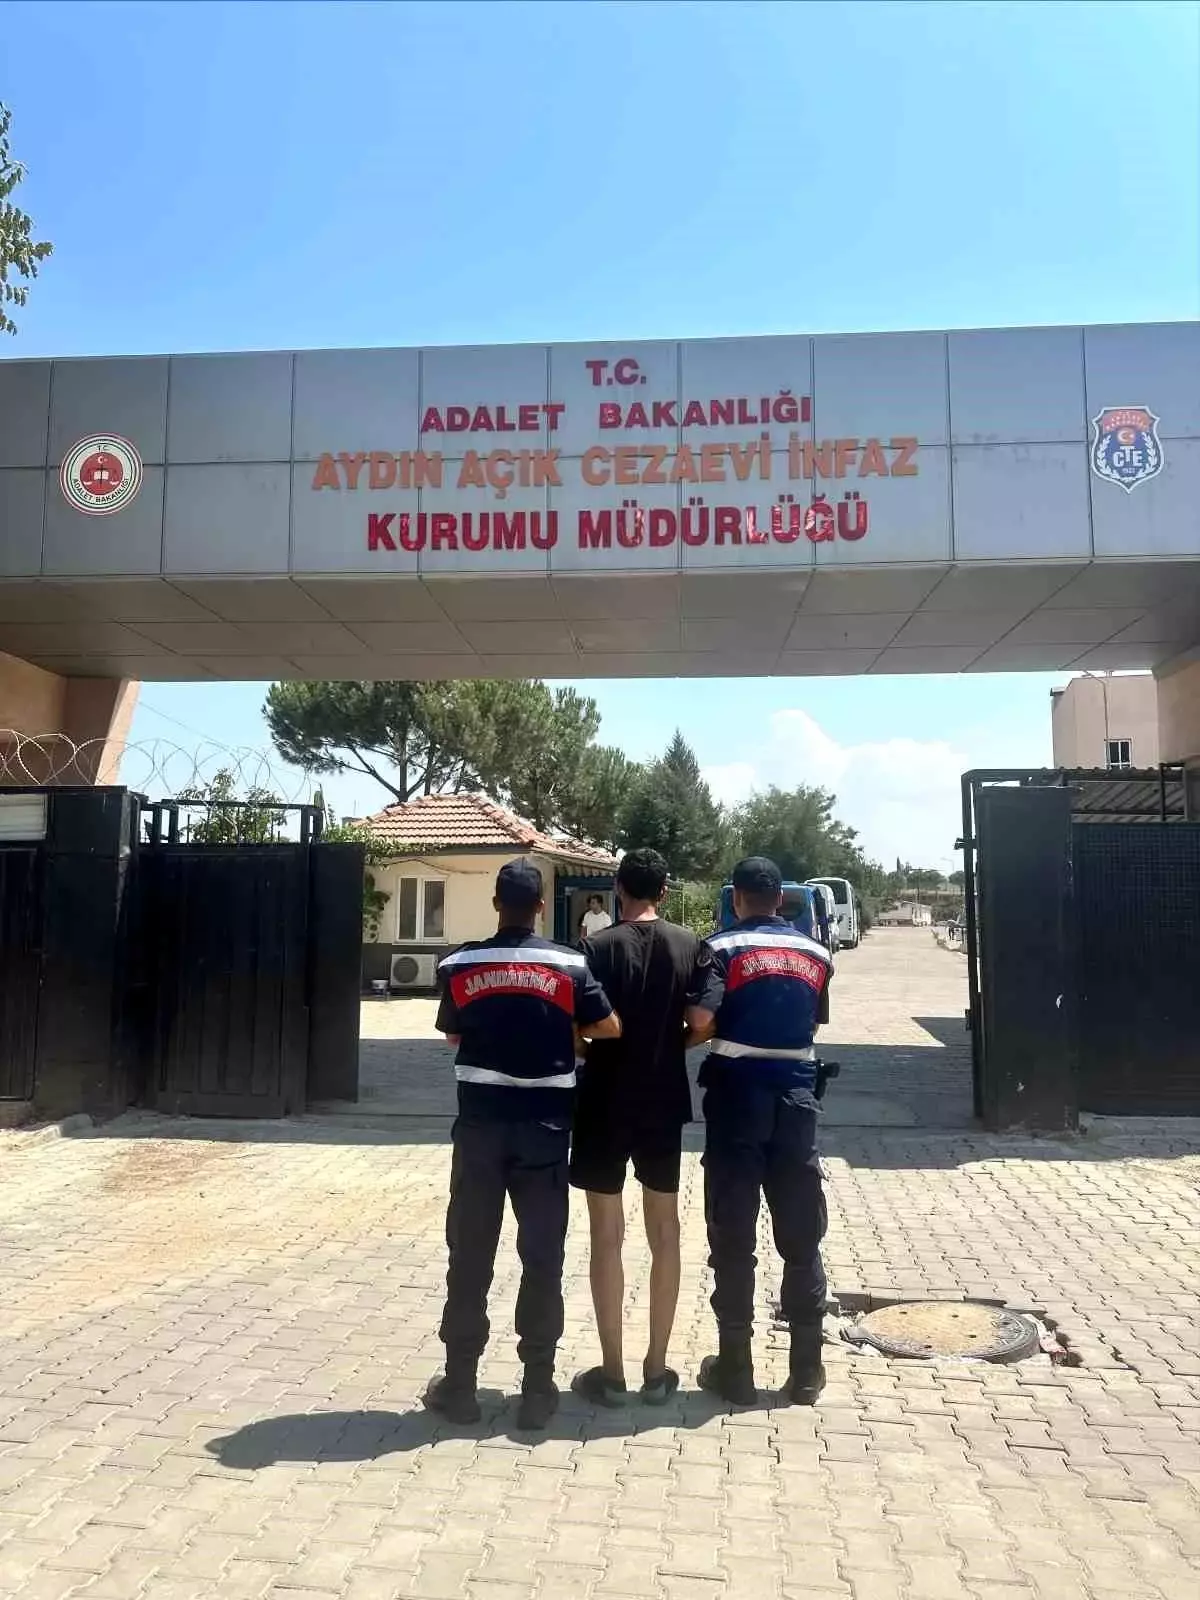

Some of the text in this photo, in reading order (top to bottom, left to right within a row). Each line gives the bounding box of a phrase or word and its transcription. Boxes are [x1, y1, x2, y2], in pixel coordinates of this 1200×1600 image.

[585, 359, 647, 386] T.C.
[420, 388, 812, 432] ADALET BAKANLIĞI
[311, 432, 920, 499] AYDIN AÇIK CEZAEVİ İNFAZ
[1112, 445, 1143, 467] CTE
[72, 479, 93, 501] ADALET
[368, 491, 867, 551] KURUMU MÜDÜRLÜĞÜ
[464, 968, 558, 996] JANDARMA
